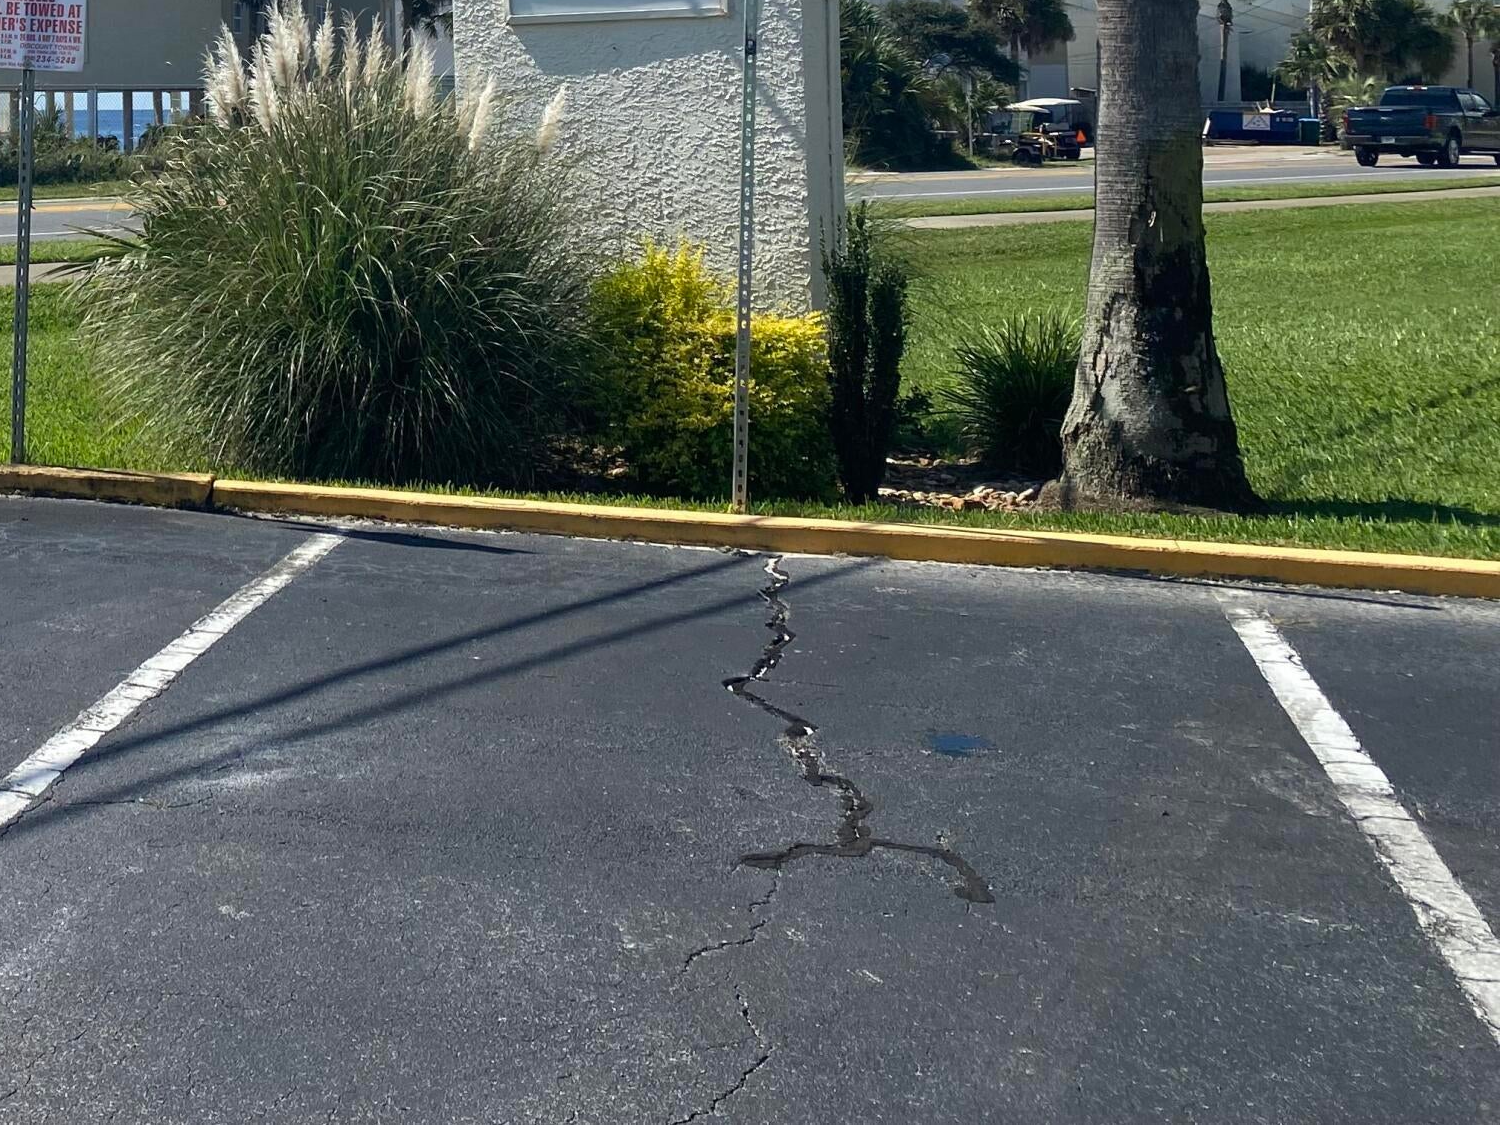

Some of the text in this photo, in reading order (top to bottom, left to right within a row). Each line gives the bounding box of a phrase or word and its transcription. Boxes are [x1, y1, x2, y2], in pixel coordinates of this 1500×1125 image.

[6, 2, 20, 16] BE
[24, 3, 64, 18] TOWED
[68, 5, 82, 18] AT
[30, 18, 82, 34] EXPENSE
[36, 55, 76, 64] 234-5248
